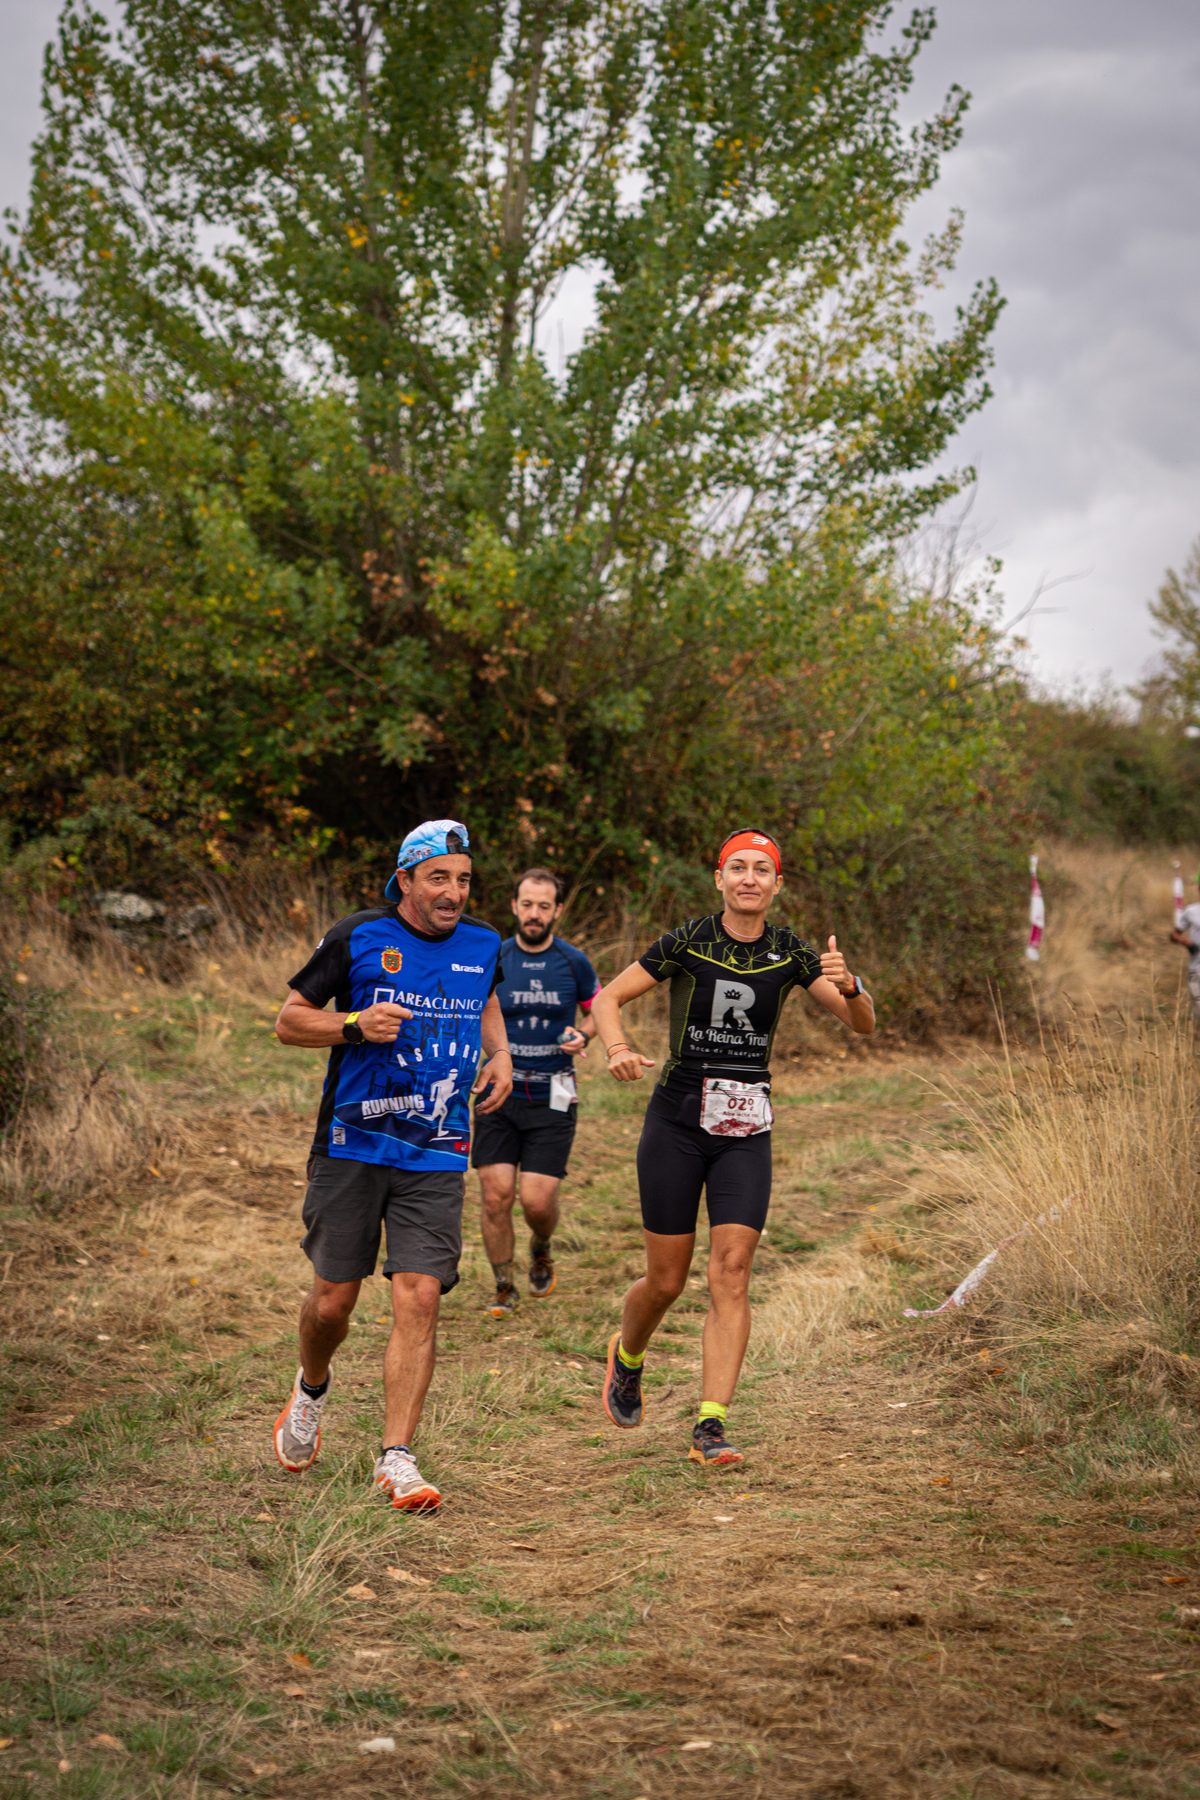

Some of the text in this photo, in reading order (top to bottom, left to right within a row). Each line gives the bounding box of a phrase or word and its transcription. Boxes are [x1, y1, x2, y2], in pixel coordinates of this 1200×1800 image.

[512, 991, 561, 1005] TRAIL
[688, 1025, 768, 1046] La Reina Trail
[361, 1094, 425, 1117] RUNNING
